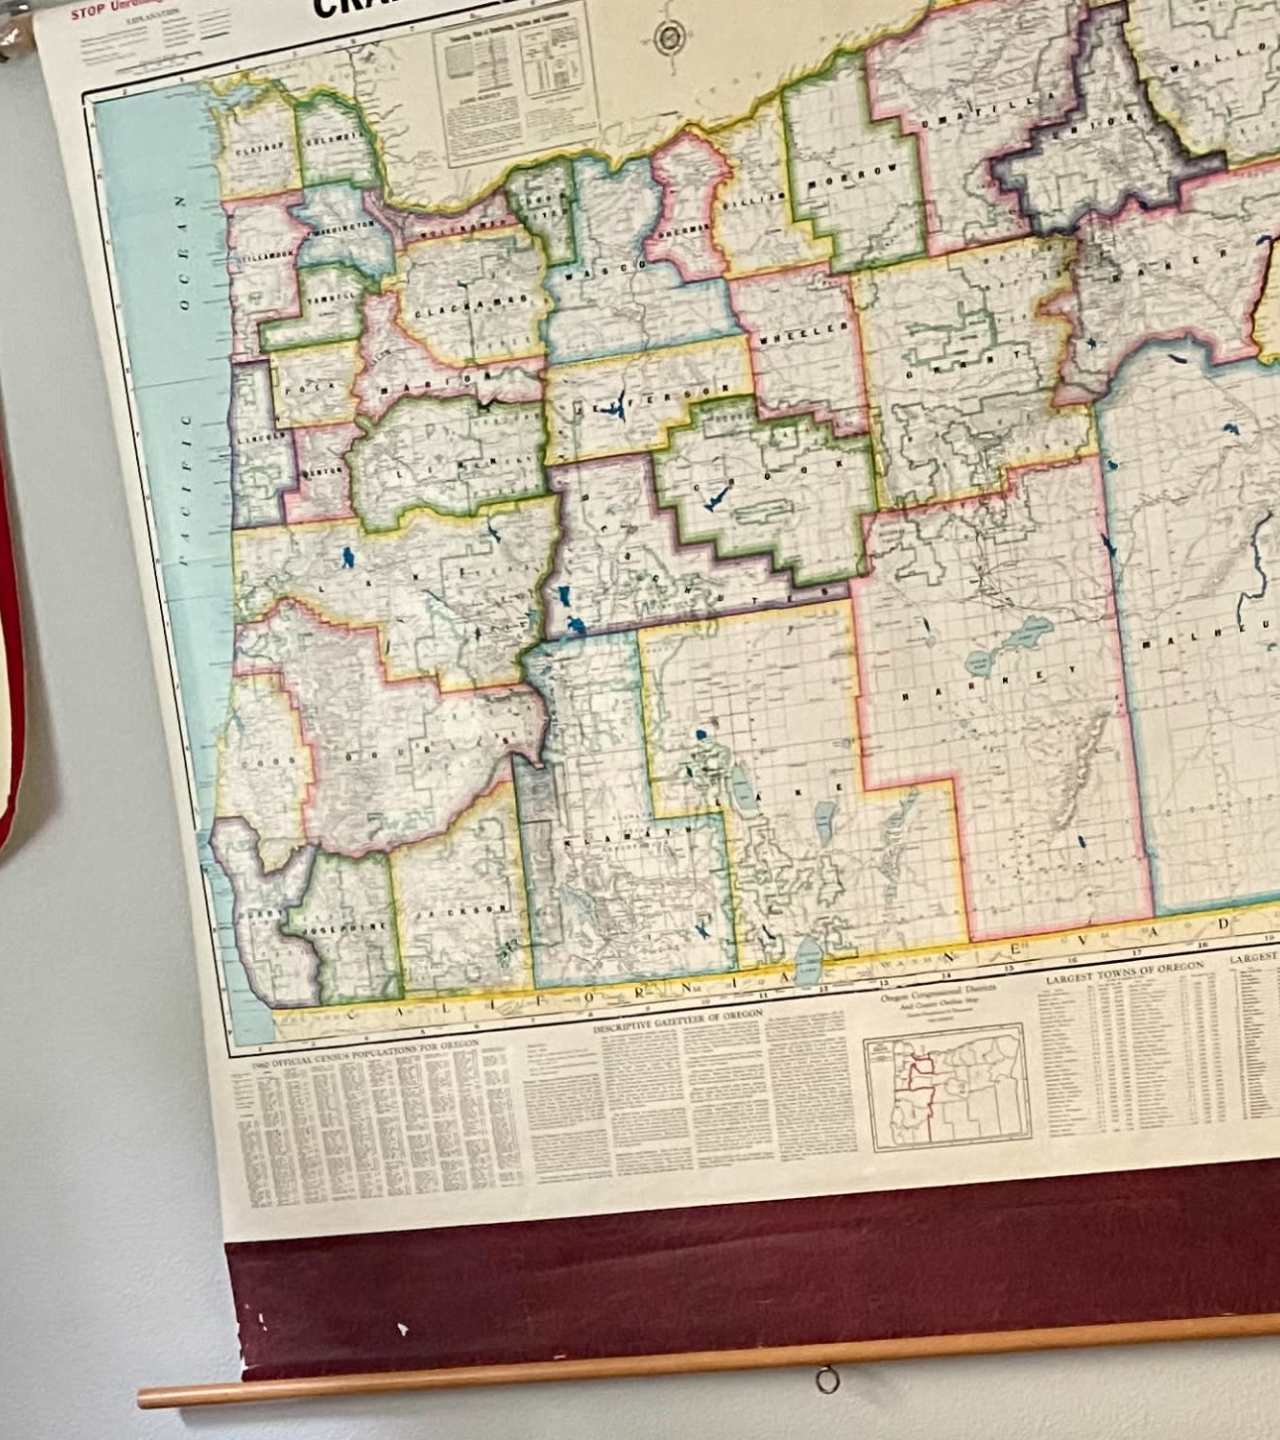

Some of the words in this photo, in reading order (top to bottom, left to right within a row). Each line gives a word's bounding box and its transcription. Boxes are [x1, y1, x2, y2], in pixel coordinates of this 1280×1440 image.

[71, 3, 105, 21] STOP
[922, 91, 1054, 129] UMATILLA
[807, 162, 897, 190] MORROW
[174, 195, 191, 312] OCEAN
[1111, 247, 1231, 285] BAKER
[565, 260, 646, 281] WASCO
[414, 293, 528, 319] CLACKAMAS
[759, 321, 849, 346] WHEELER
[906, 350, 1022, 381] GRANT
[379, 370, 492, 396] MARION
[178, 415, 193, 568] PACIFIC
[901, 664, 1076, 702] HARNEY
[564, 825, 692, 847] KLAMATH
[416, 903, 506, 919] JACKSON
[1230, 951, 1278, 965] LARGEST
[1046, 972, 1094, 986] LARGEST
[1098, 967, 1137, 979] TOWNS
[1140, 965, 1155, 975] OF
[1157, 960, 1205, 974] OREGON
[593, 1020, 652, 1035] DESCRIPTIVE
[723, 1007, 764, 1021] OREGON
[271, 1055, 313, 1068] OFFICIAL
[315, 1052, 350, 1064] CENSUS
[352, 1044, 419, 1060] POPULATIONS
[419, 1042, 438, 1052] FOR
[440, 1038, 481, 1050] OREGON
